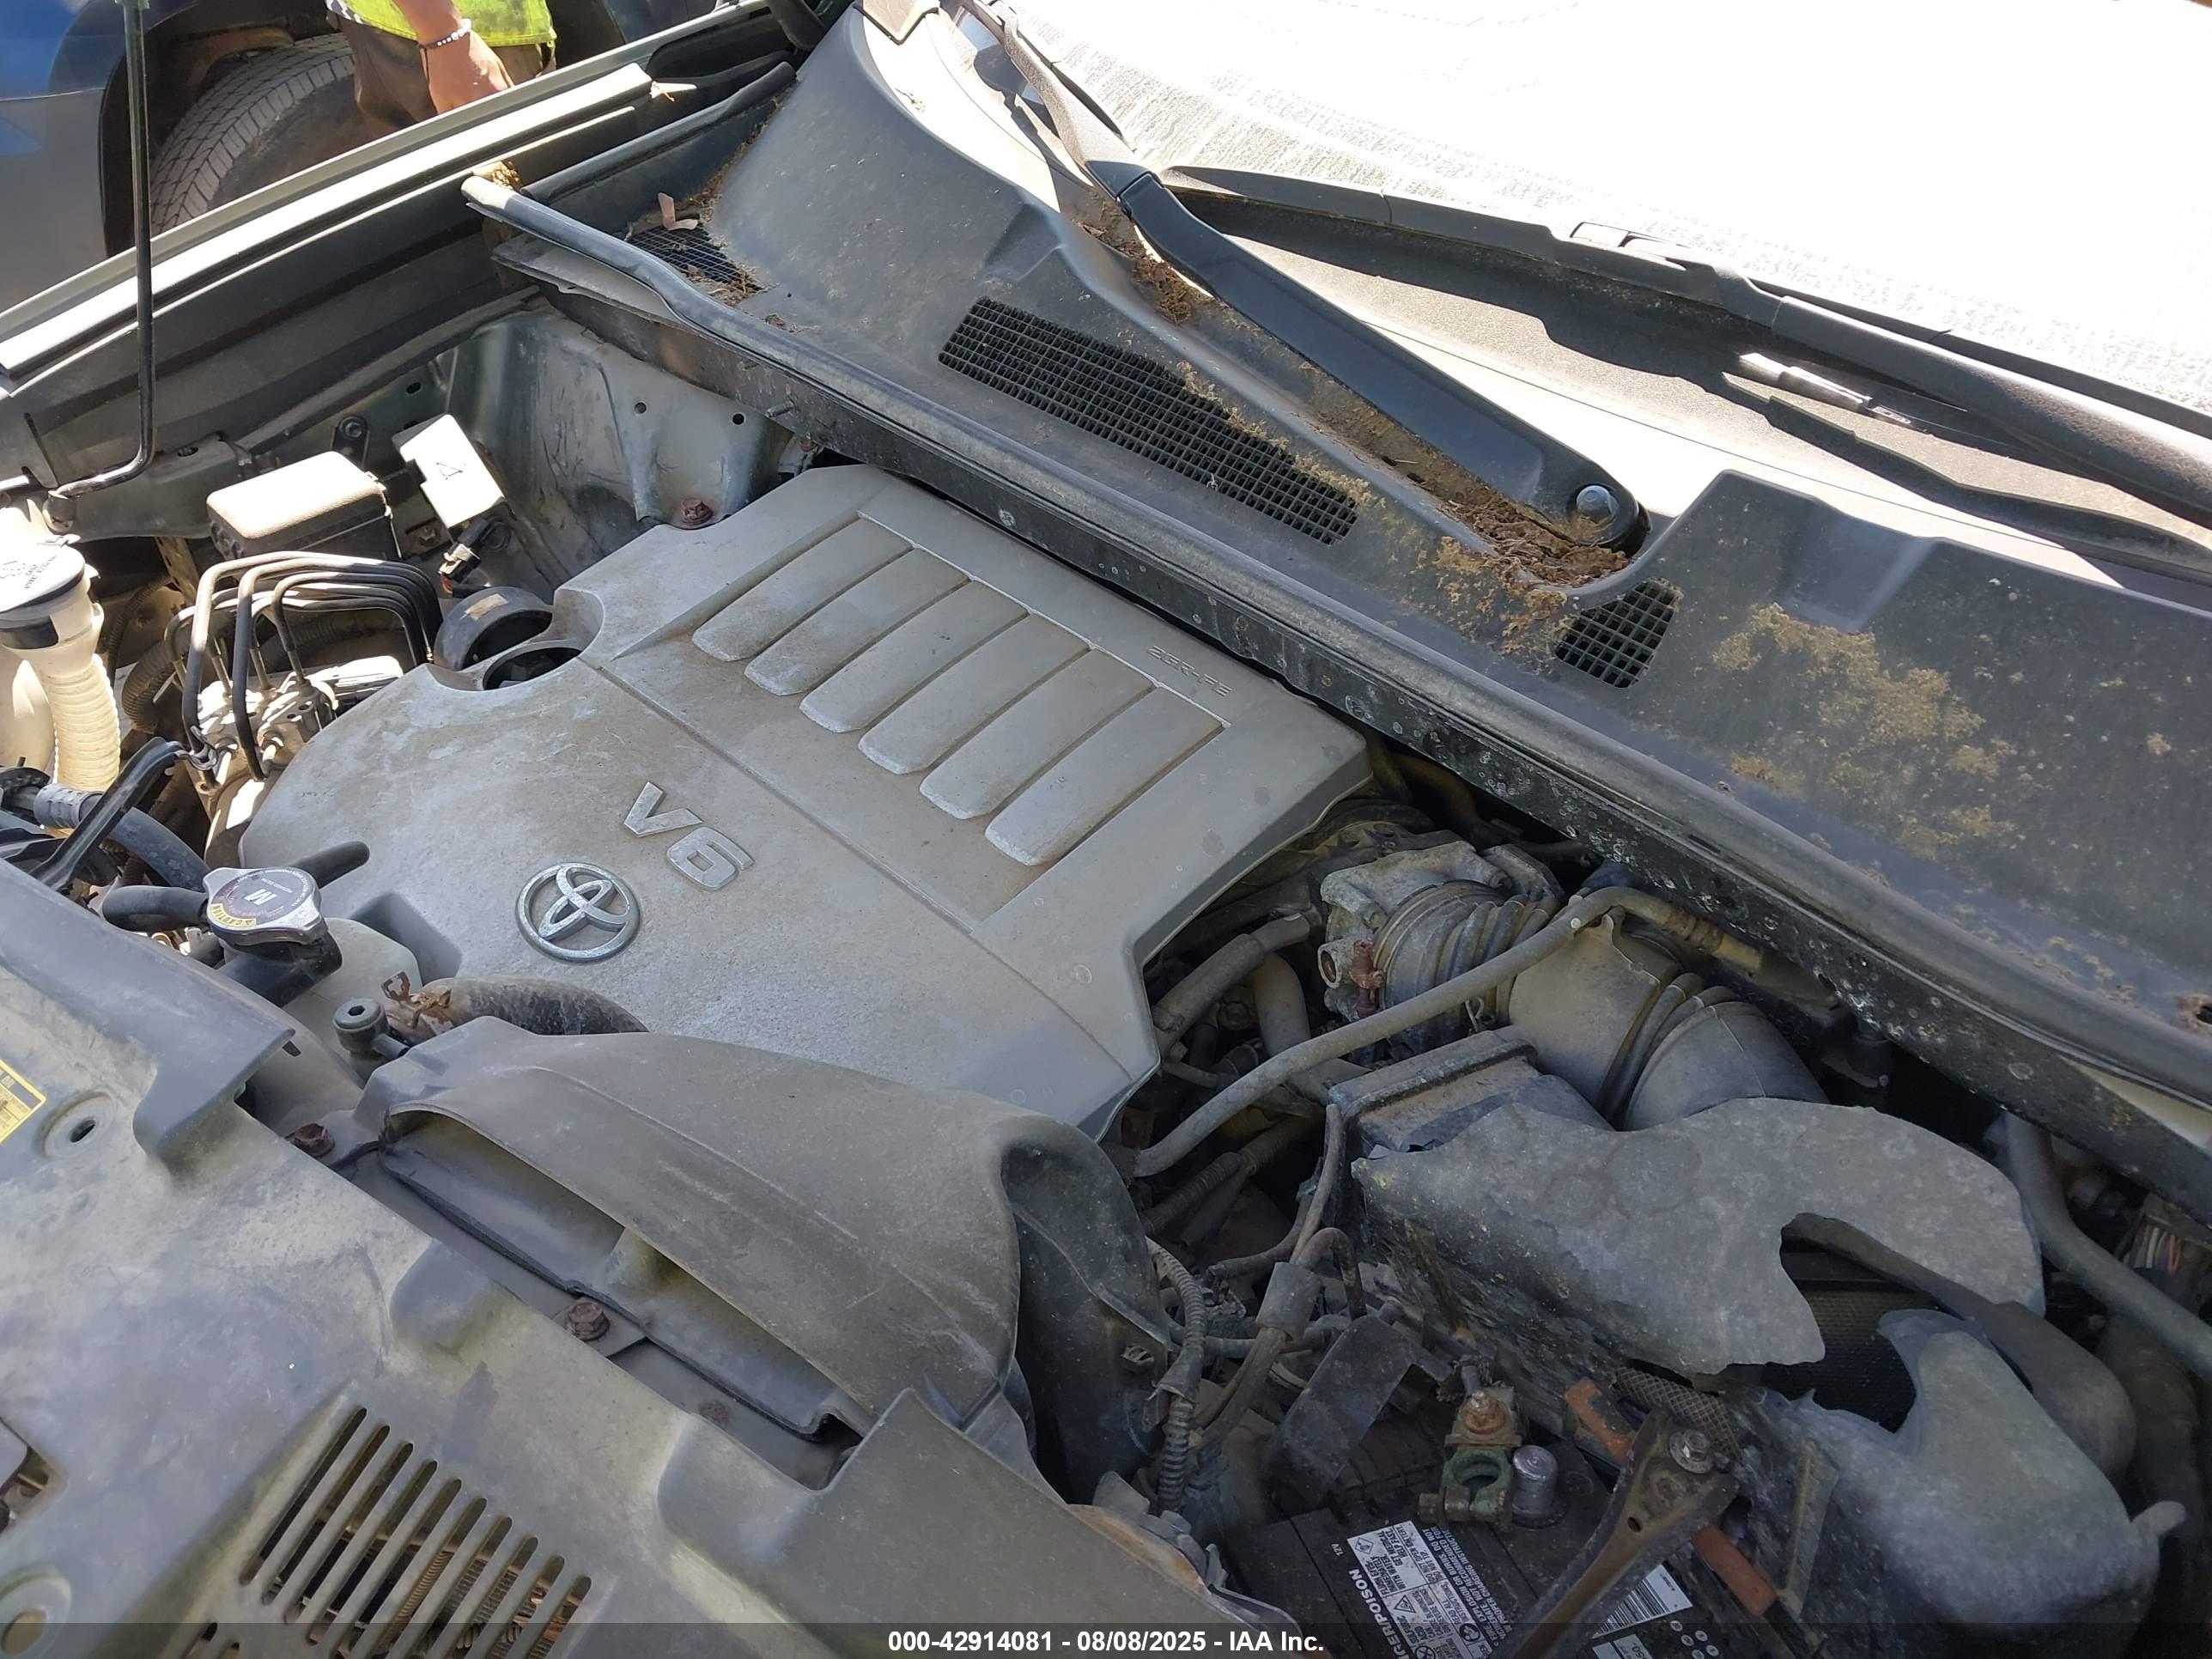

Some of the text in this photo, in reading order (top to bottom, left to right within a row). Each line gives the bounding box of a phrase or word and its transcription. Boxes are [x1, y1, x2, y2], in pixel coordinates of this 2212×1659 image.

[623, 781, 756, 891] V6
[212, 905, 243, 926] CAUTION
[1420, 1527, 1435, 1541] NOT
[1329, 1542, 1344, 1558] 12V
[1430, 1540, 1442, 1552] DO
[1390, 1554, 1403, 1566] GET
[1408, 1547, 1423, 1562] OPEN
[1438, 1539, 1474, 1587] RECOMMENDED
[1391, 1573, 1407, 1590] WITH
[1451, 1574, 1464, 1586] OR
[1463, 1564, 1491, 1597] CHARGING
[1468, 1587, 1483, 1601] NOT
[1458, 1585, 1486, 1622] EXPLOSION
